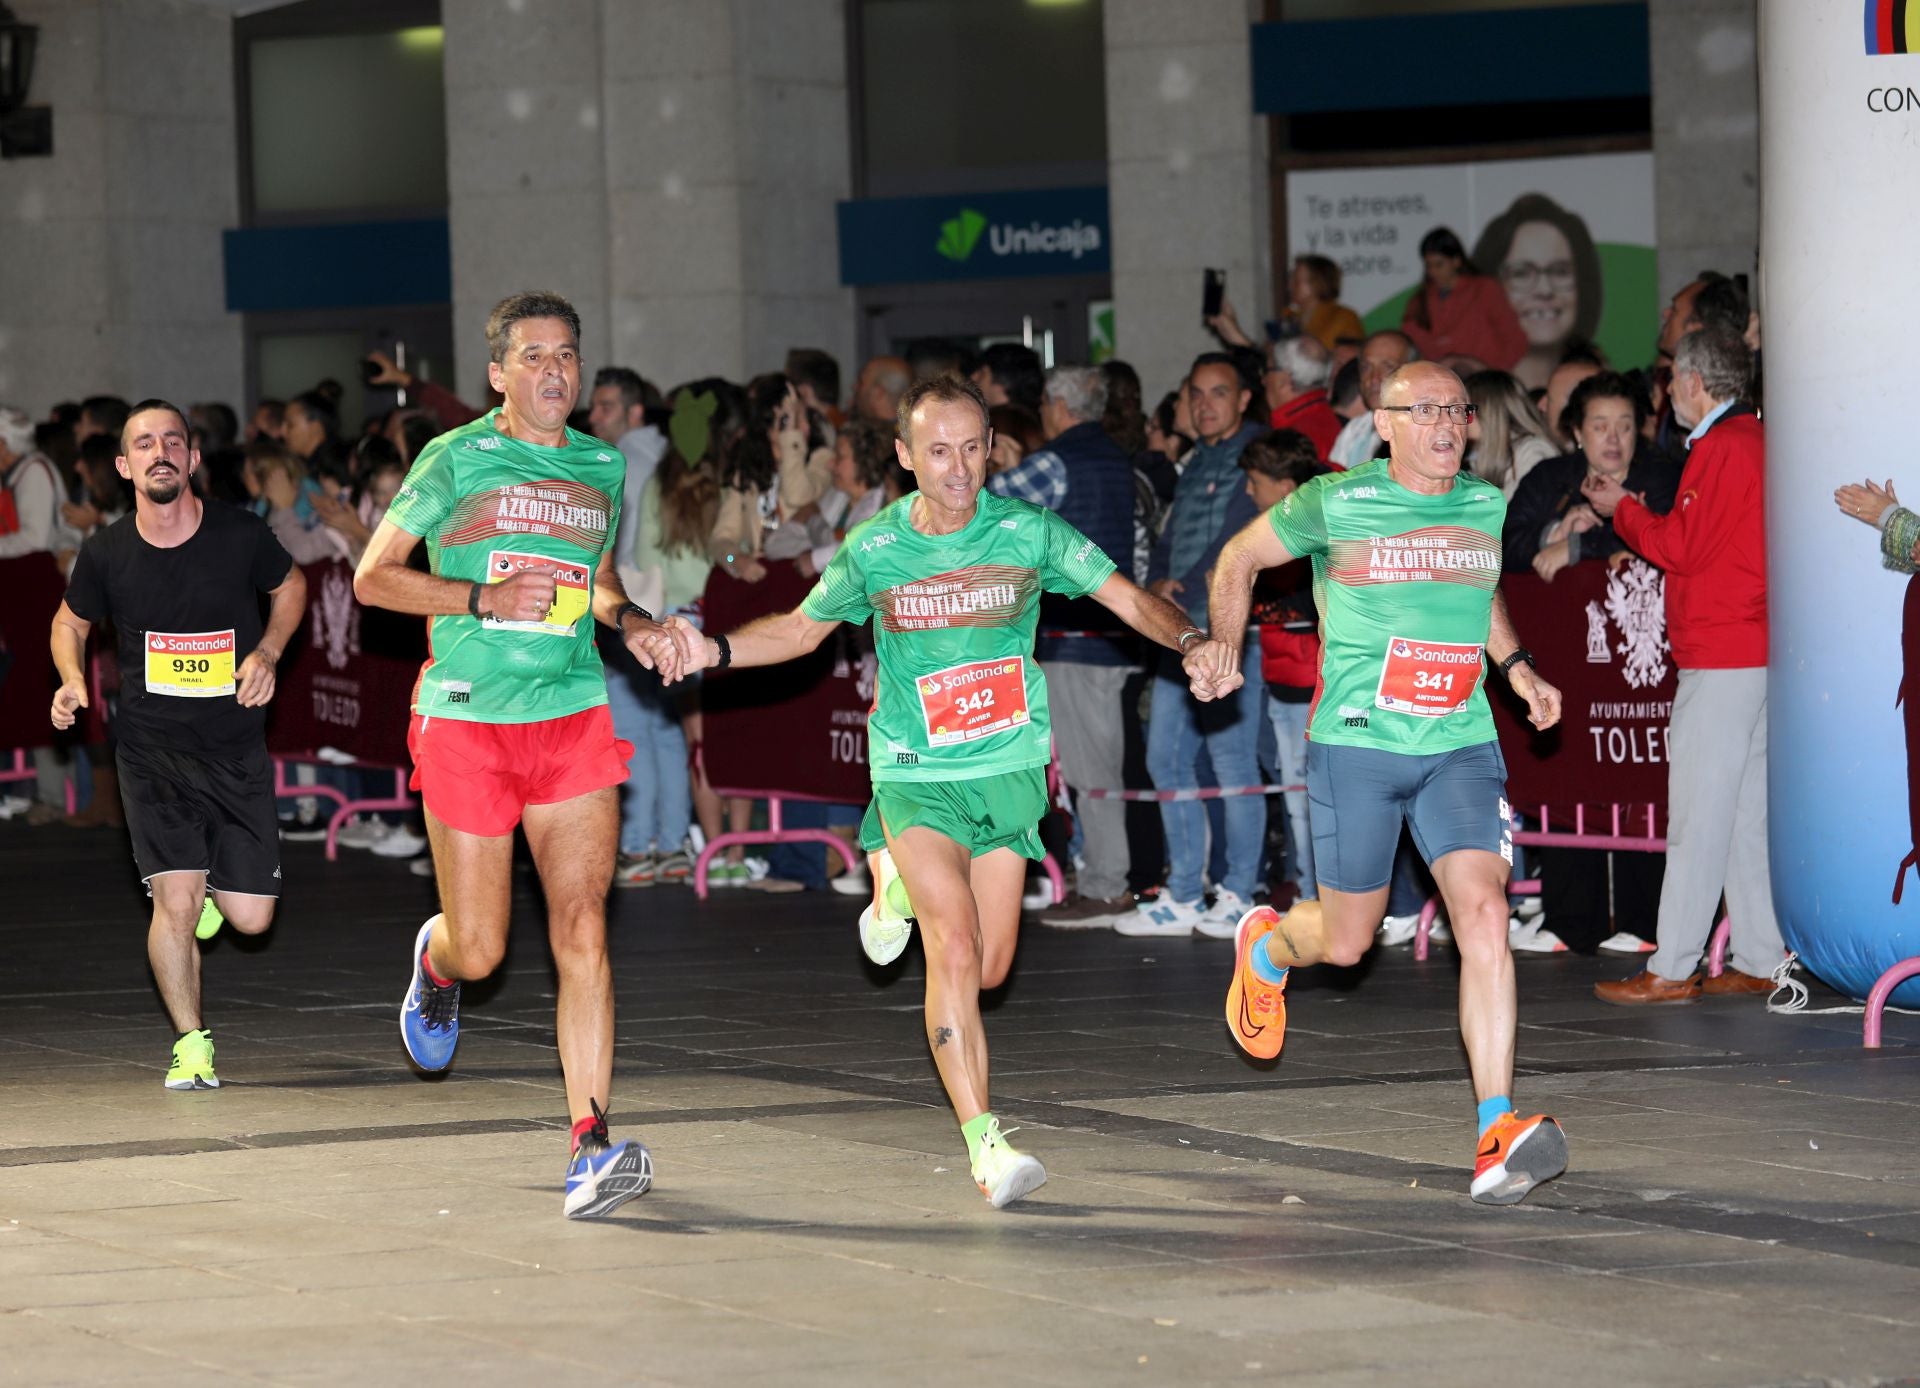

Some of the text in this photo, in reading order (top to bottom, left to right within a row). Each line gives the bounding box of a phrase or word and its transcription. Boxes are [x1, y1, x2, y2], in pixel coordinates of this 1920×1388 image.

[1306, 195, 1334, 219] Te
[990, 220, 1101, 260] Unicaja
[1306, 225, 1399, 252] y la vida
[477, 437, 502, 451] 2024
[514, 486, 536, 497] MEDIA
[1352, 486, 1378, 499] 2024
[497, 497, 607, 531] AZKOITIAZPEITIA
[496, 519, 550, 535] MARATOI ERDIA
[872, 532, 897, 547] 2024
[1385, 537, 1409, 548] MEDIA
[1370, 548, 1499, 570] AZKOITIAZPEITIA
[1369, 570, 1433, 581] MARATOI ERDIA
[891, 585, 903, 595] 31.
[903, 585, 926, 595] MEDIA
[895, 584, 1016, 617] AZKOITIAZPEITIA
[928, 619, 950, 629] ERDIA
[168, 637, 232, 651] Santander
[1413, 647, 1480, 664] Santander
[172, 659, 209, 673] 930
[1413, 670, 1454, 690] 341
[448, 691, 470, 704] FESTA
[955, 688, 995, 716] 342
[1415, 693, 1448, 702] ANTONIO
[967, 712, 992, 725] JAVIER
[1344, 717, 1368, 729] FESTA
[896, 752, 919, 765] FESTA
